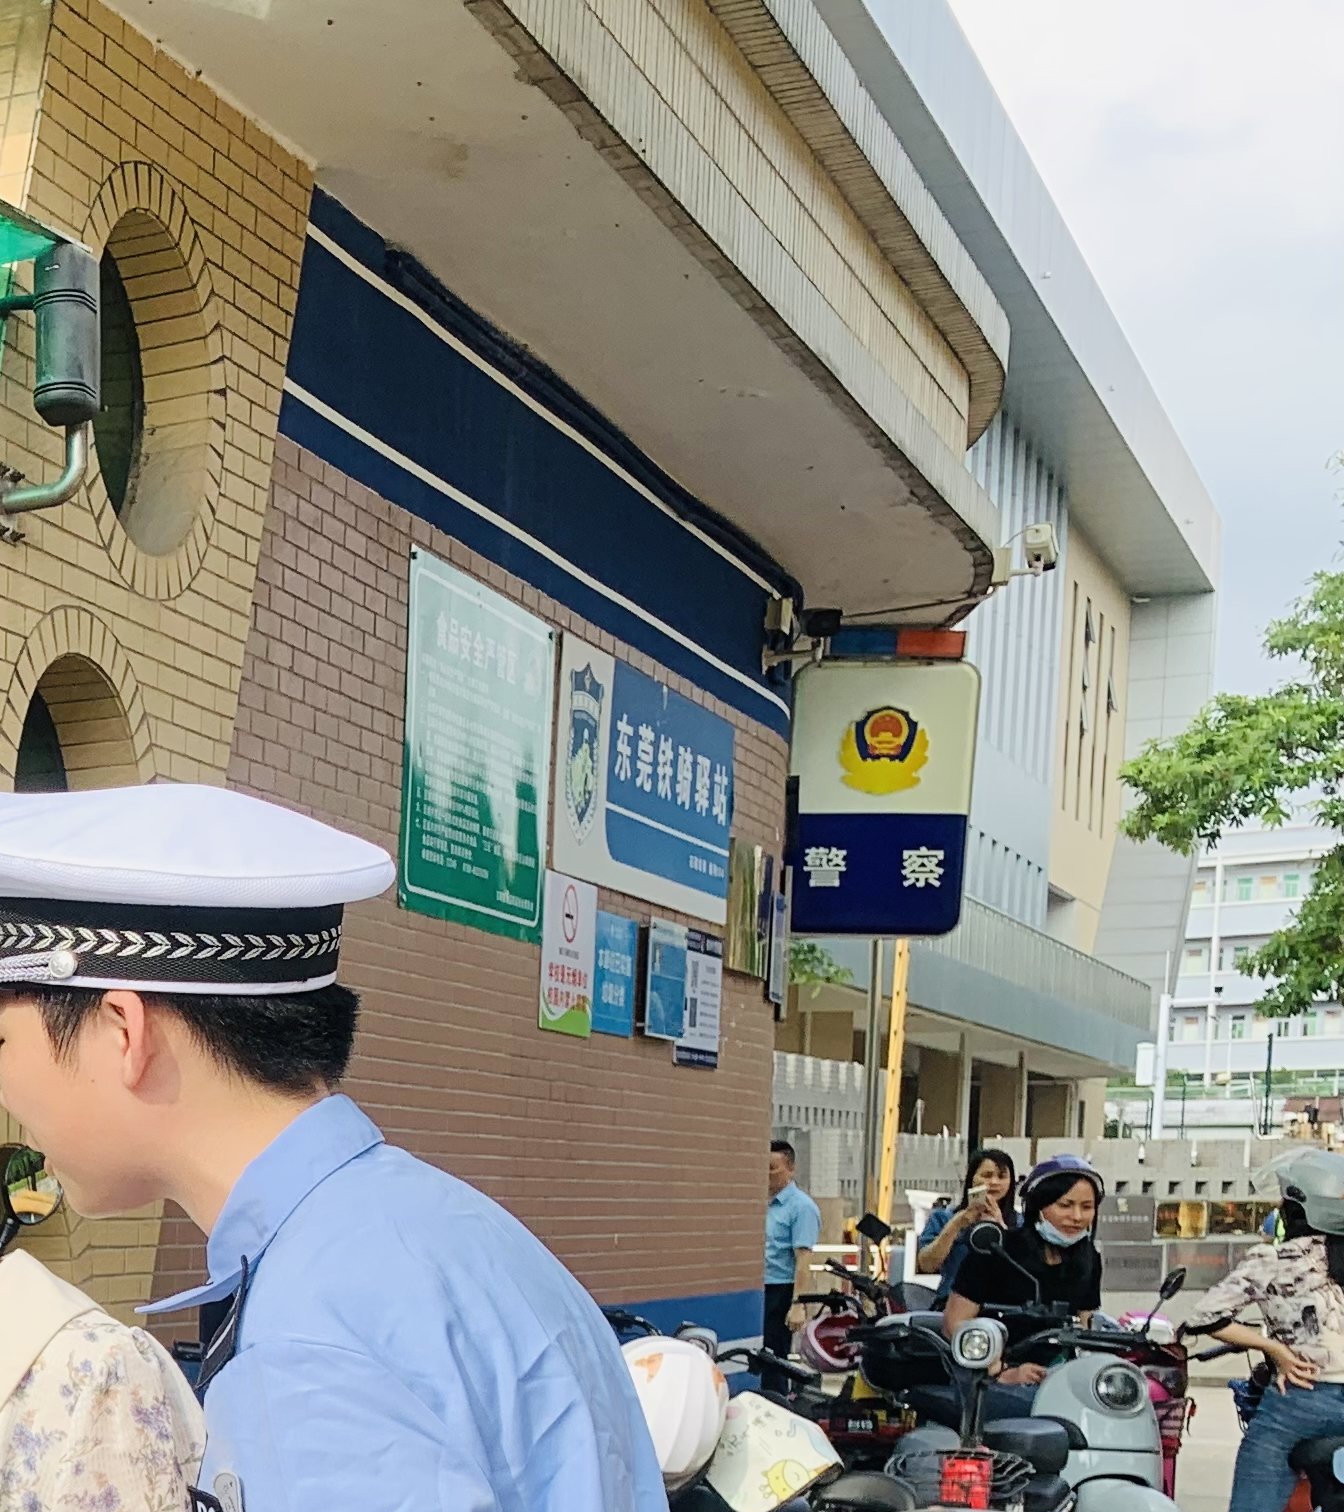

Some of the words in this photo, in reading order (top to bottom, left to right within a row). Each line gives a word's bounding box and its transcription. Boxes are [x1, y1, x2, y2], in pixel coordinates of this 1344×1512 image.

[614, 712, 729, 827] 东莞铁骑驿站
[803, 846, 945, 888] 警察
